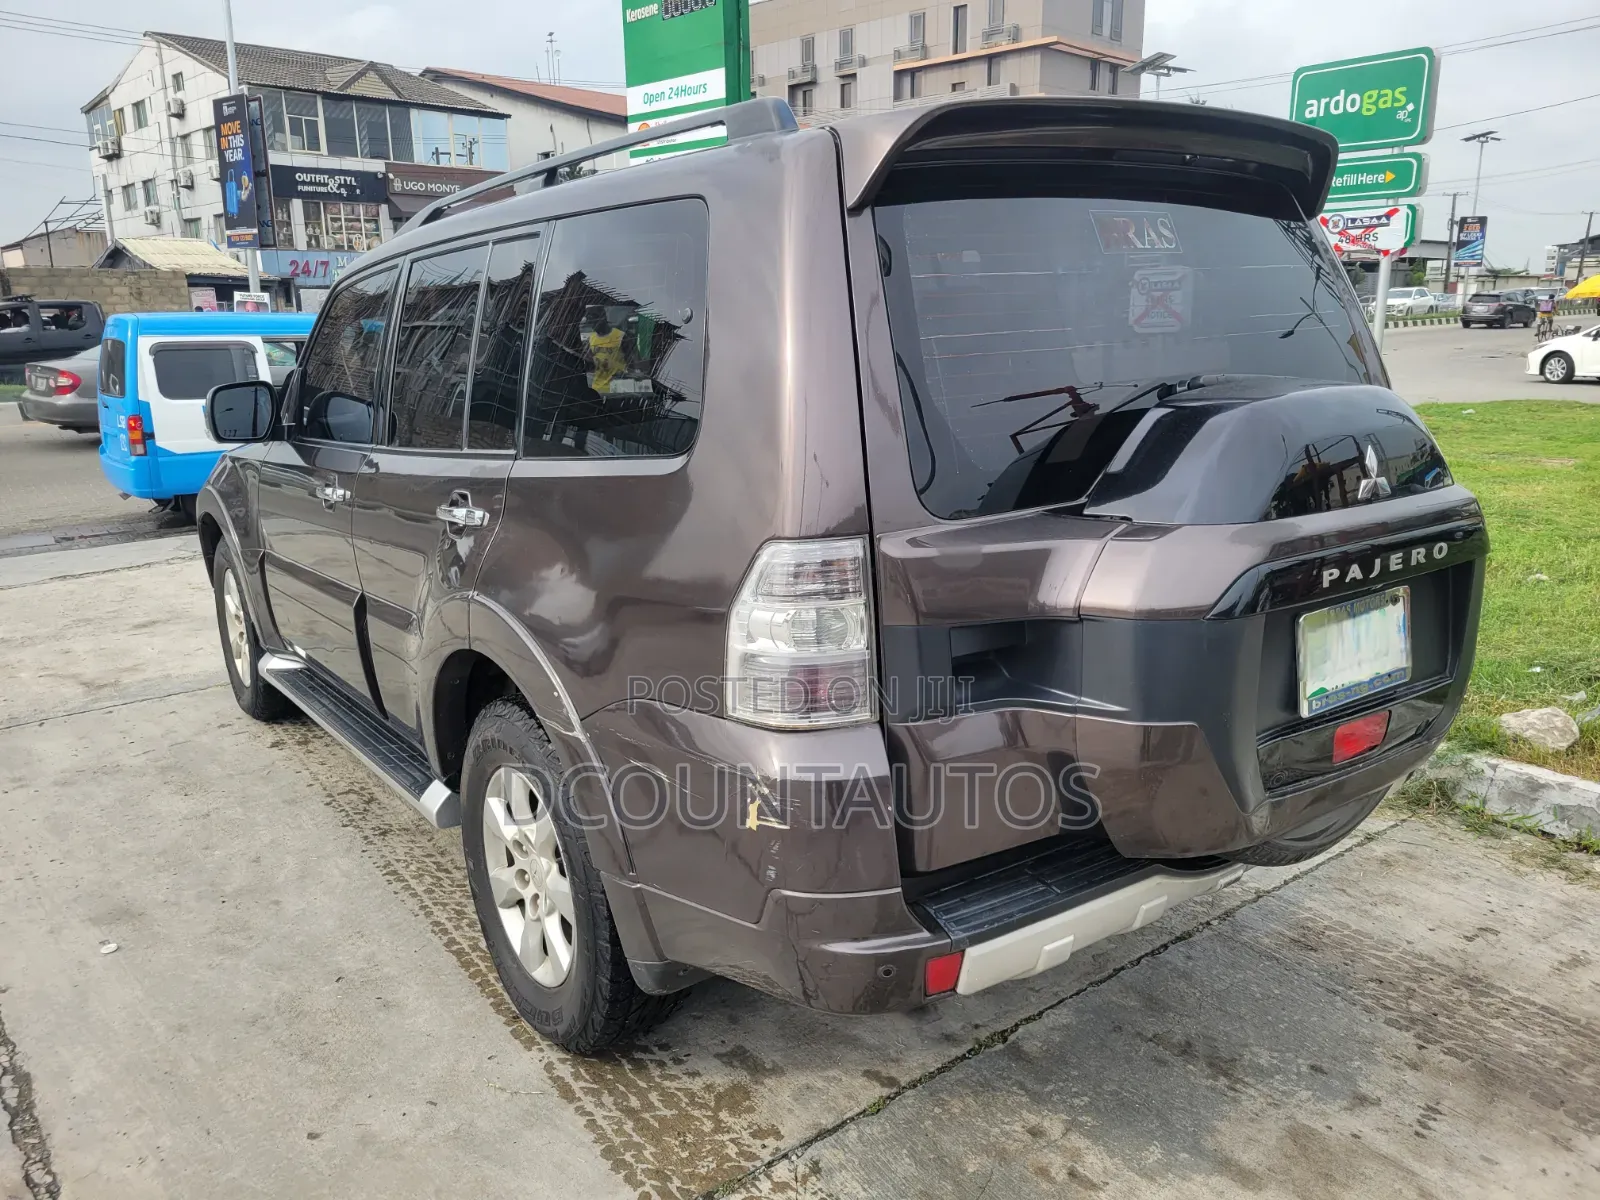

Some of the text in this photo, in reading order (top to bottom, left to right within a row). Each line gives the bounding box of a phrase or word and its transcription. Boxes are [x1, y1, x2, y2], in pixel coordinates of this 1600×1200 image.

[626, 3, 659, 23] Kerosene
[643, 82, 708, 107] Open 24Hours
[1304, 86, 1407, 118] ardogas
[220, 120, 242, 136] MOVE
[220, 133, 245, 150] IN THIS
[224, 148, 245, 163] YEAR.
[295, 172, 329, 184] OUTFIT
[334, 175, 357, 186] STYL
[1357, 172, 1385, 185] Here
[297, 185, 328, 193] FUNITURE
[403, 180, 461, 193] UGO MONYE
[1347, 216, 1388, 227] LASAA
[1338, 232, 1379, 243] 48 HRS
[289, 259, 330, 278] 24/7
[1322, 542, 1449, 588] PAJERO
